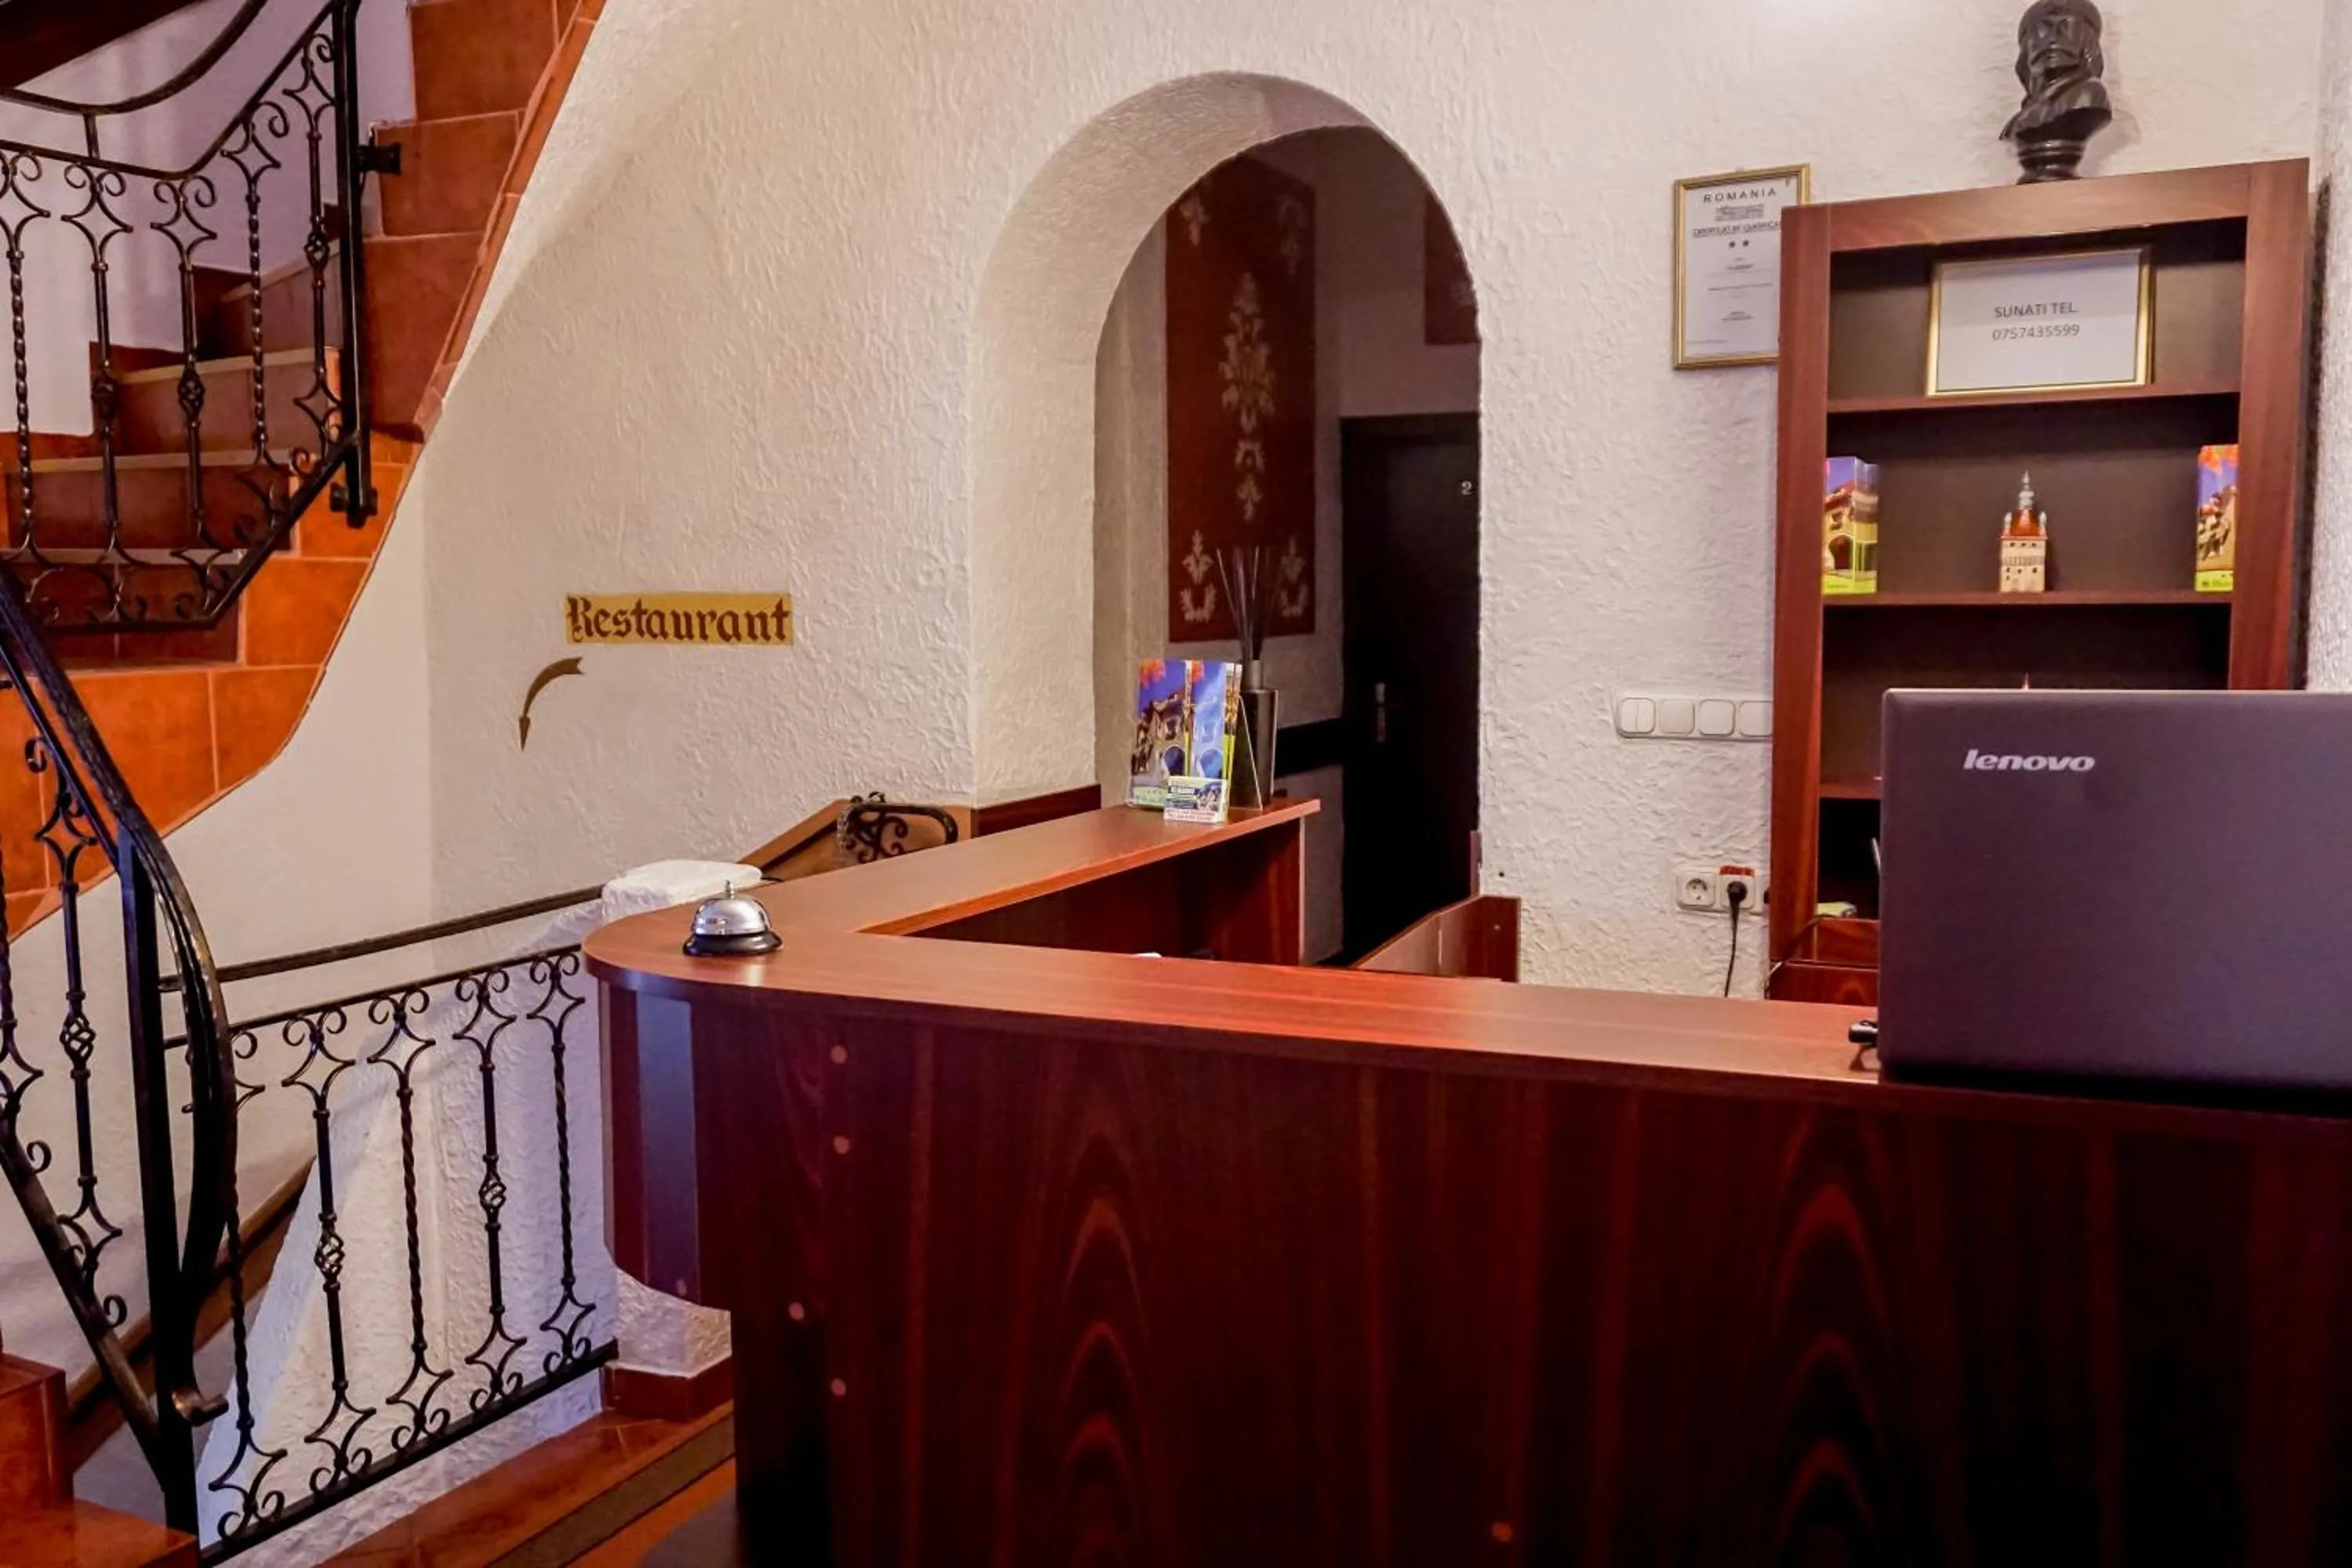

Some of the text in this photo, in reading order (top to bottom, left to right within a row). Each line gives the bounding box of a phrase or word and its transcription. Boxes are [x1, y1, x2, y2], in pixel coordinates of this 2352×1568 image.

[1704, 188, 1777, 203] ROMANIA
[1994, 303, 2047, 318] SUNATI
[1992, 324, 2080, 340] 0757435599
[1461, 481, 1472, 495] 2
[566, 596, 789, 643] Restaurant
[1963, 749, 2096, 771] lenovo
